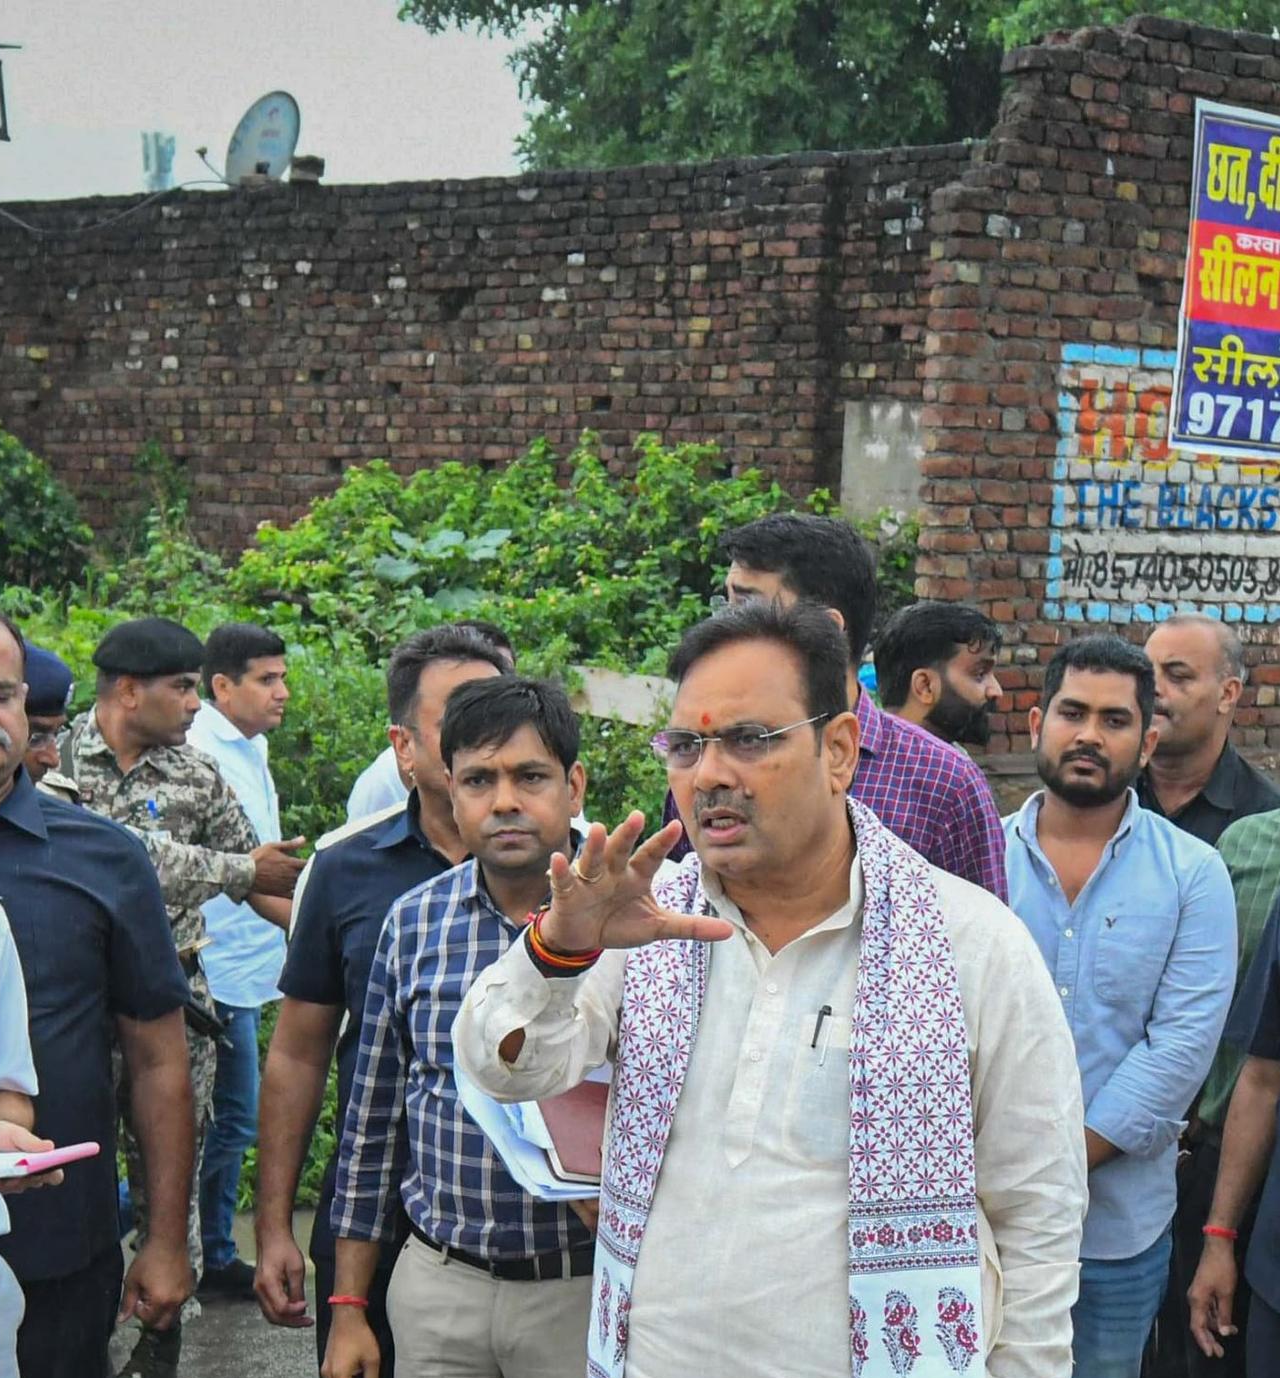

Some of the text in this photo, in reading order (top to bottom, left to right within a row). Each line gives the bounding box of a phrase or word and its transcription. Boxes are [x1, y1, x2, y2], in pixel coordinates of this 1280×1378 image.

[1206, 142, 1256, 220] छत,
[1198, 234, 1280, 309] सीलन
[1076, 479, 1142, 528] THE
